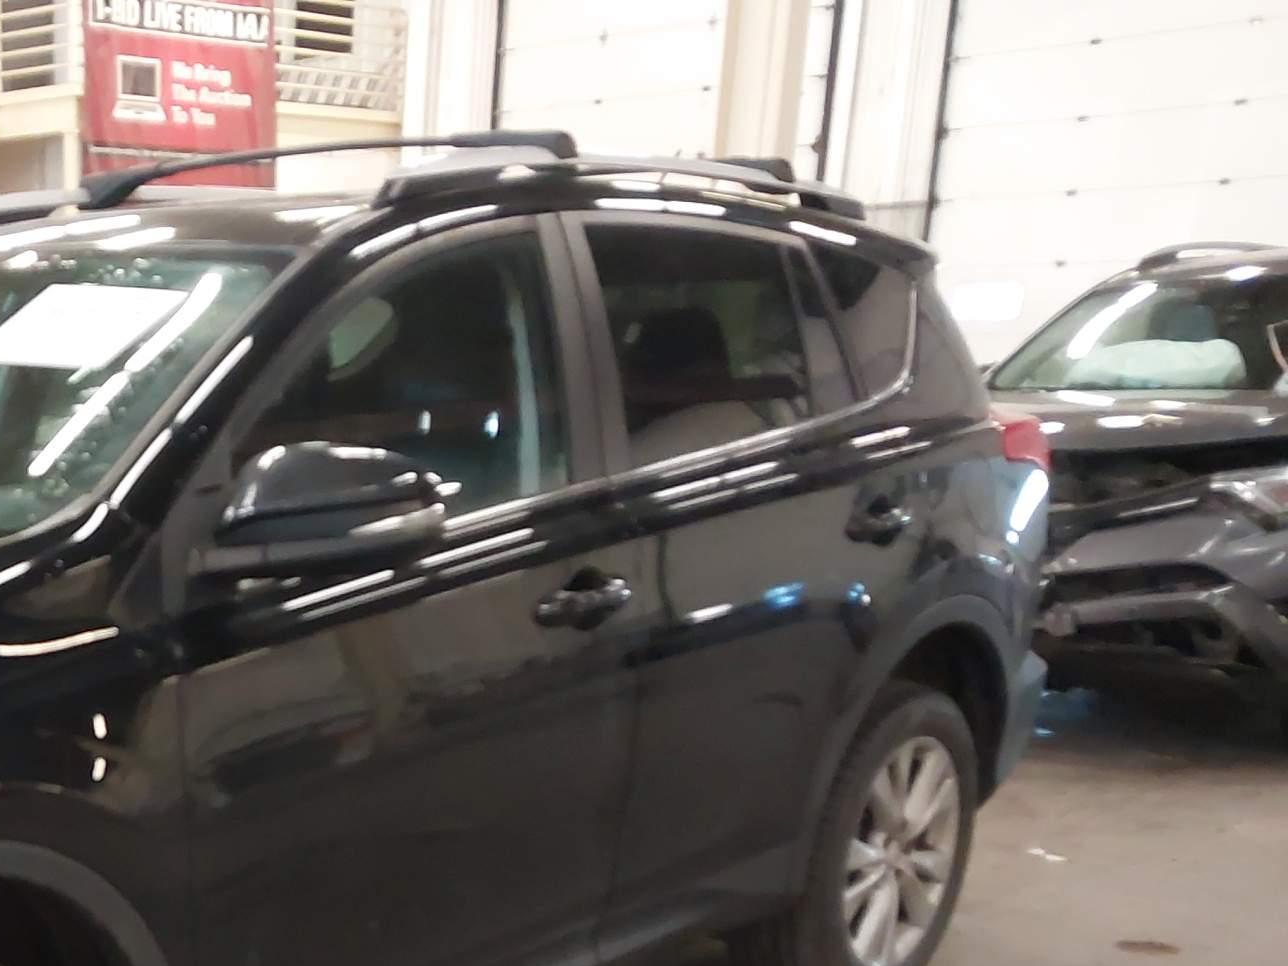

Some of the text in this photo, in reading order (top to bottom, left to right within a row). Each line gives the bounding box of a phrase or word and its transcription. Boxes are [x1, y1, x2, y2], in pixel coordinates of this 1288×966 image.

[143, 0, 183, 33] LIVE
[184, 4, 235, 38] FROM
[194, 62, 232, 87] Bring
[172, 83, 253, 106] The Auction
[171, 104, 189, 123] To
